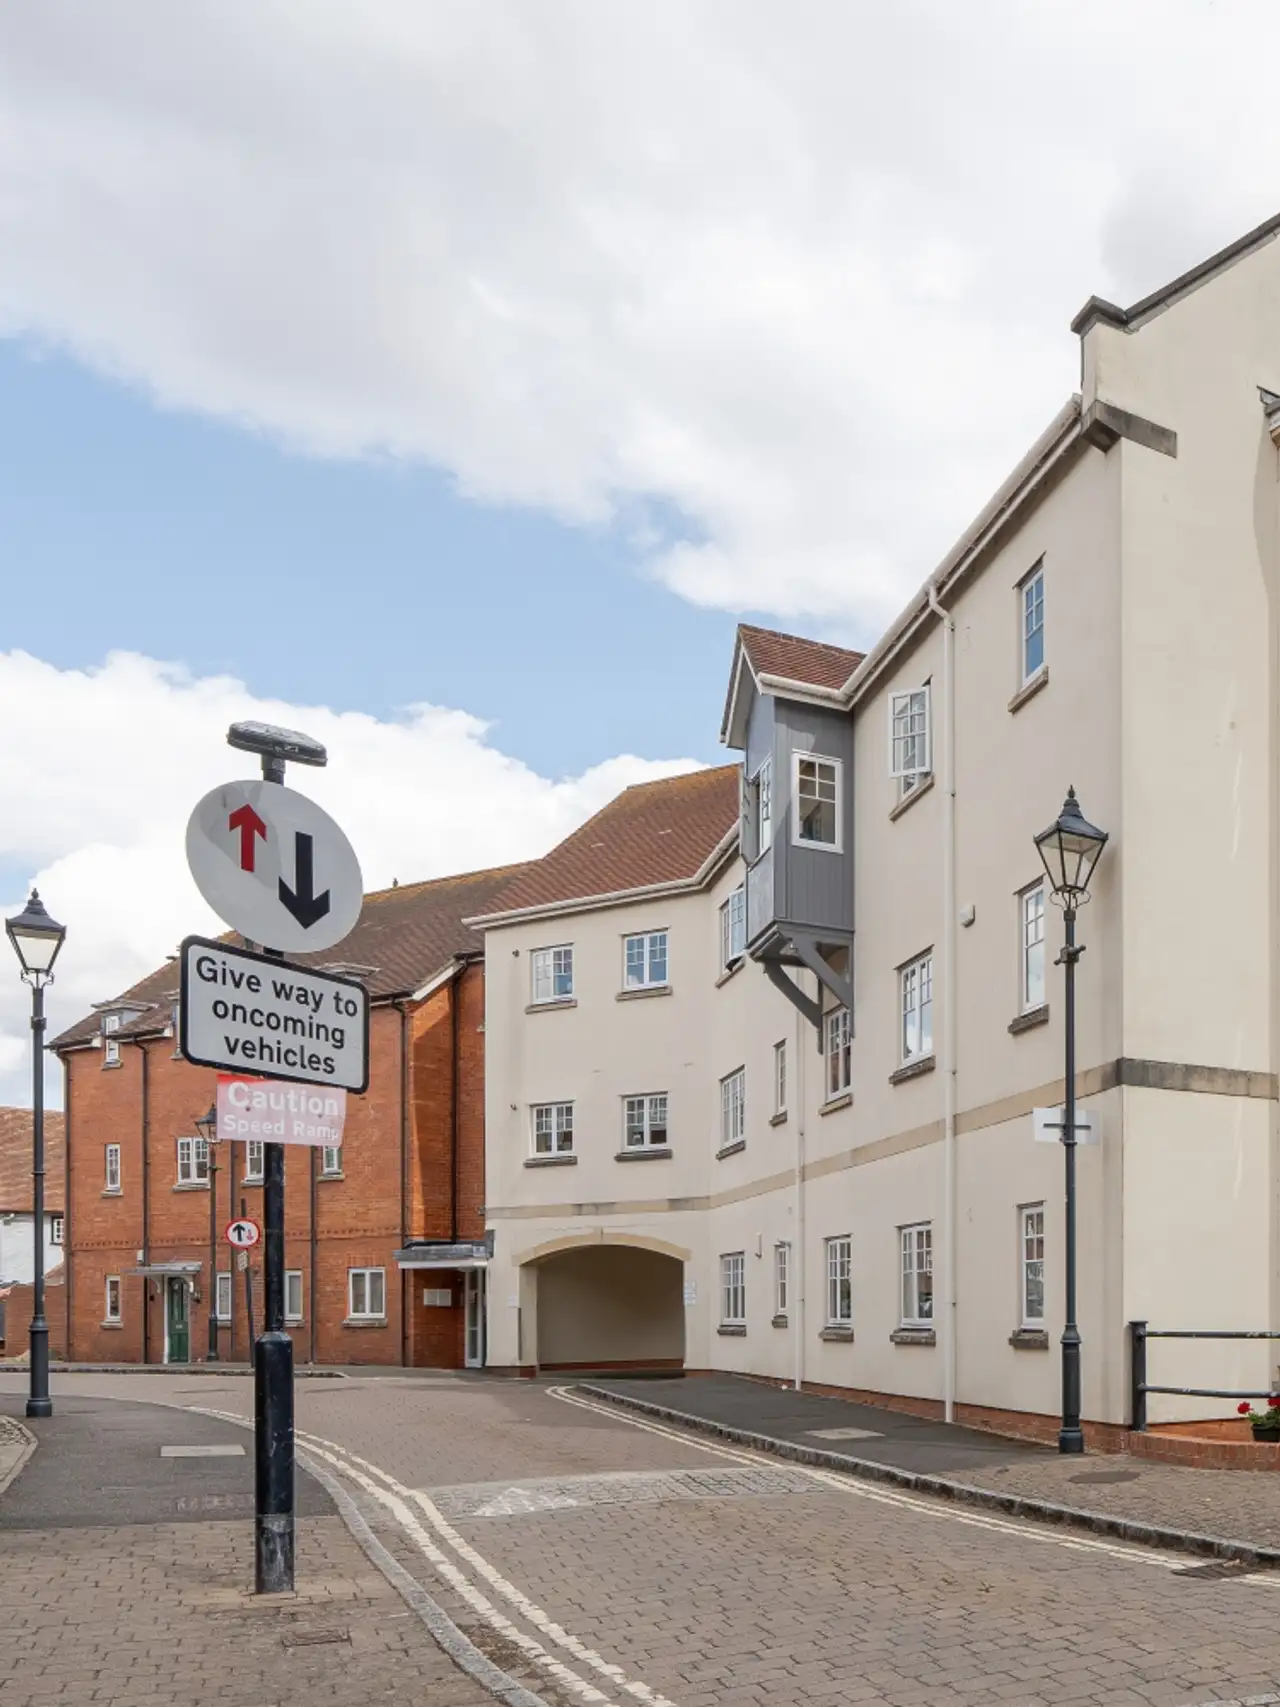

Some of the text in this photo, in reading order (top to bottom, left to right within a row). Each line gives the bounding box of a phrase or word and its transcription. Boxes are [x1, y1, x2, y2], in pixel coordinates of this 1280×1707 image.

[196, 956, 358, 1017] Give way to
[212, 1000, 344, 1049] oncoming
[224, 1036, 335, 1076] vehicles
[228, 1082, 338, 1116] Caution
[223, 1114, 340, 1140] Speed Ramp
